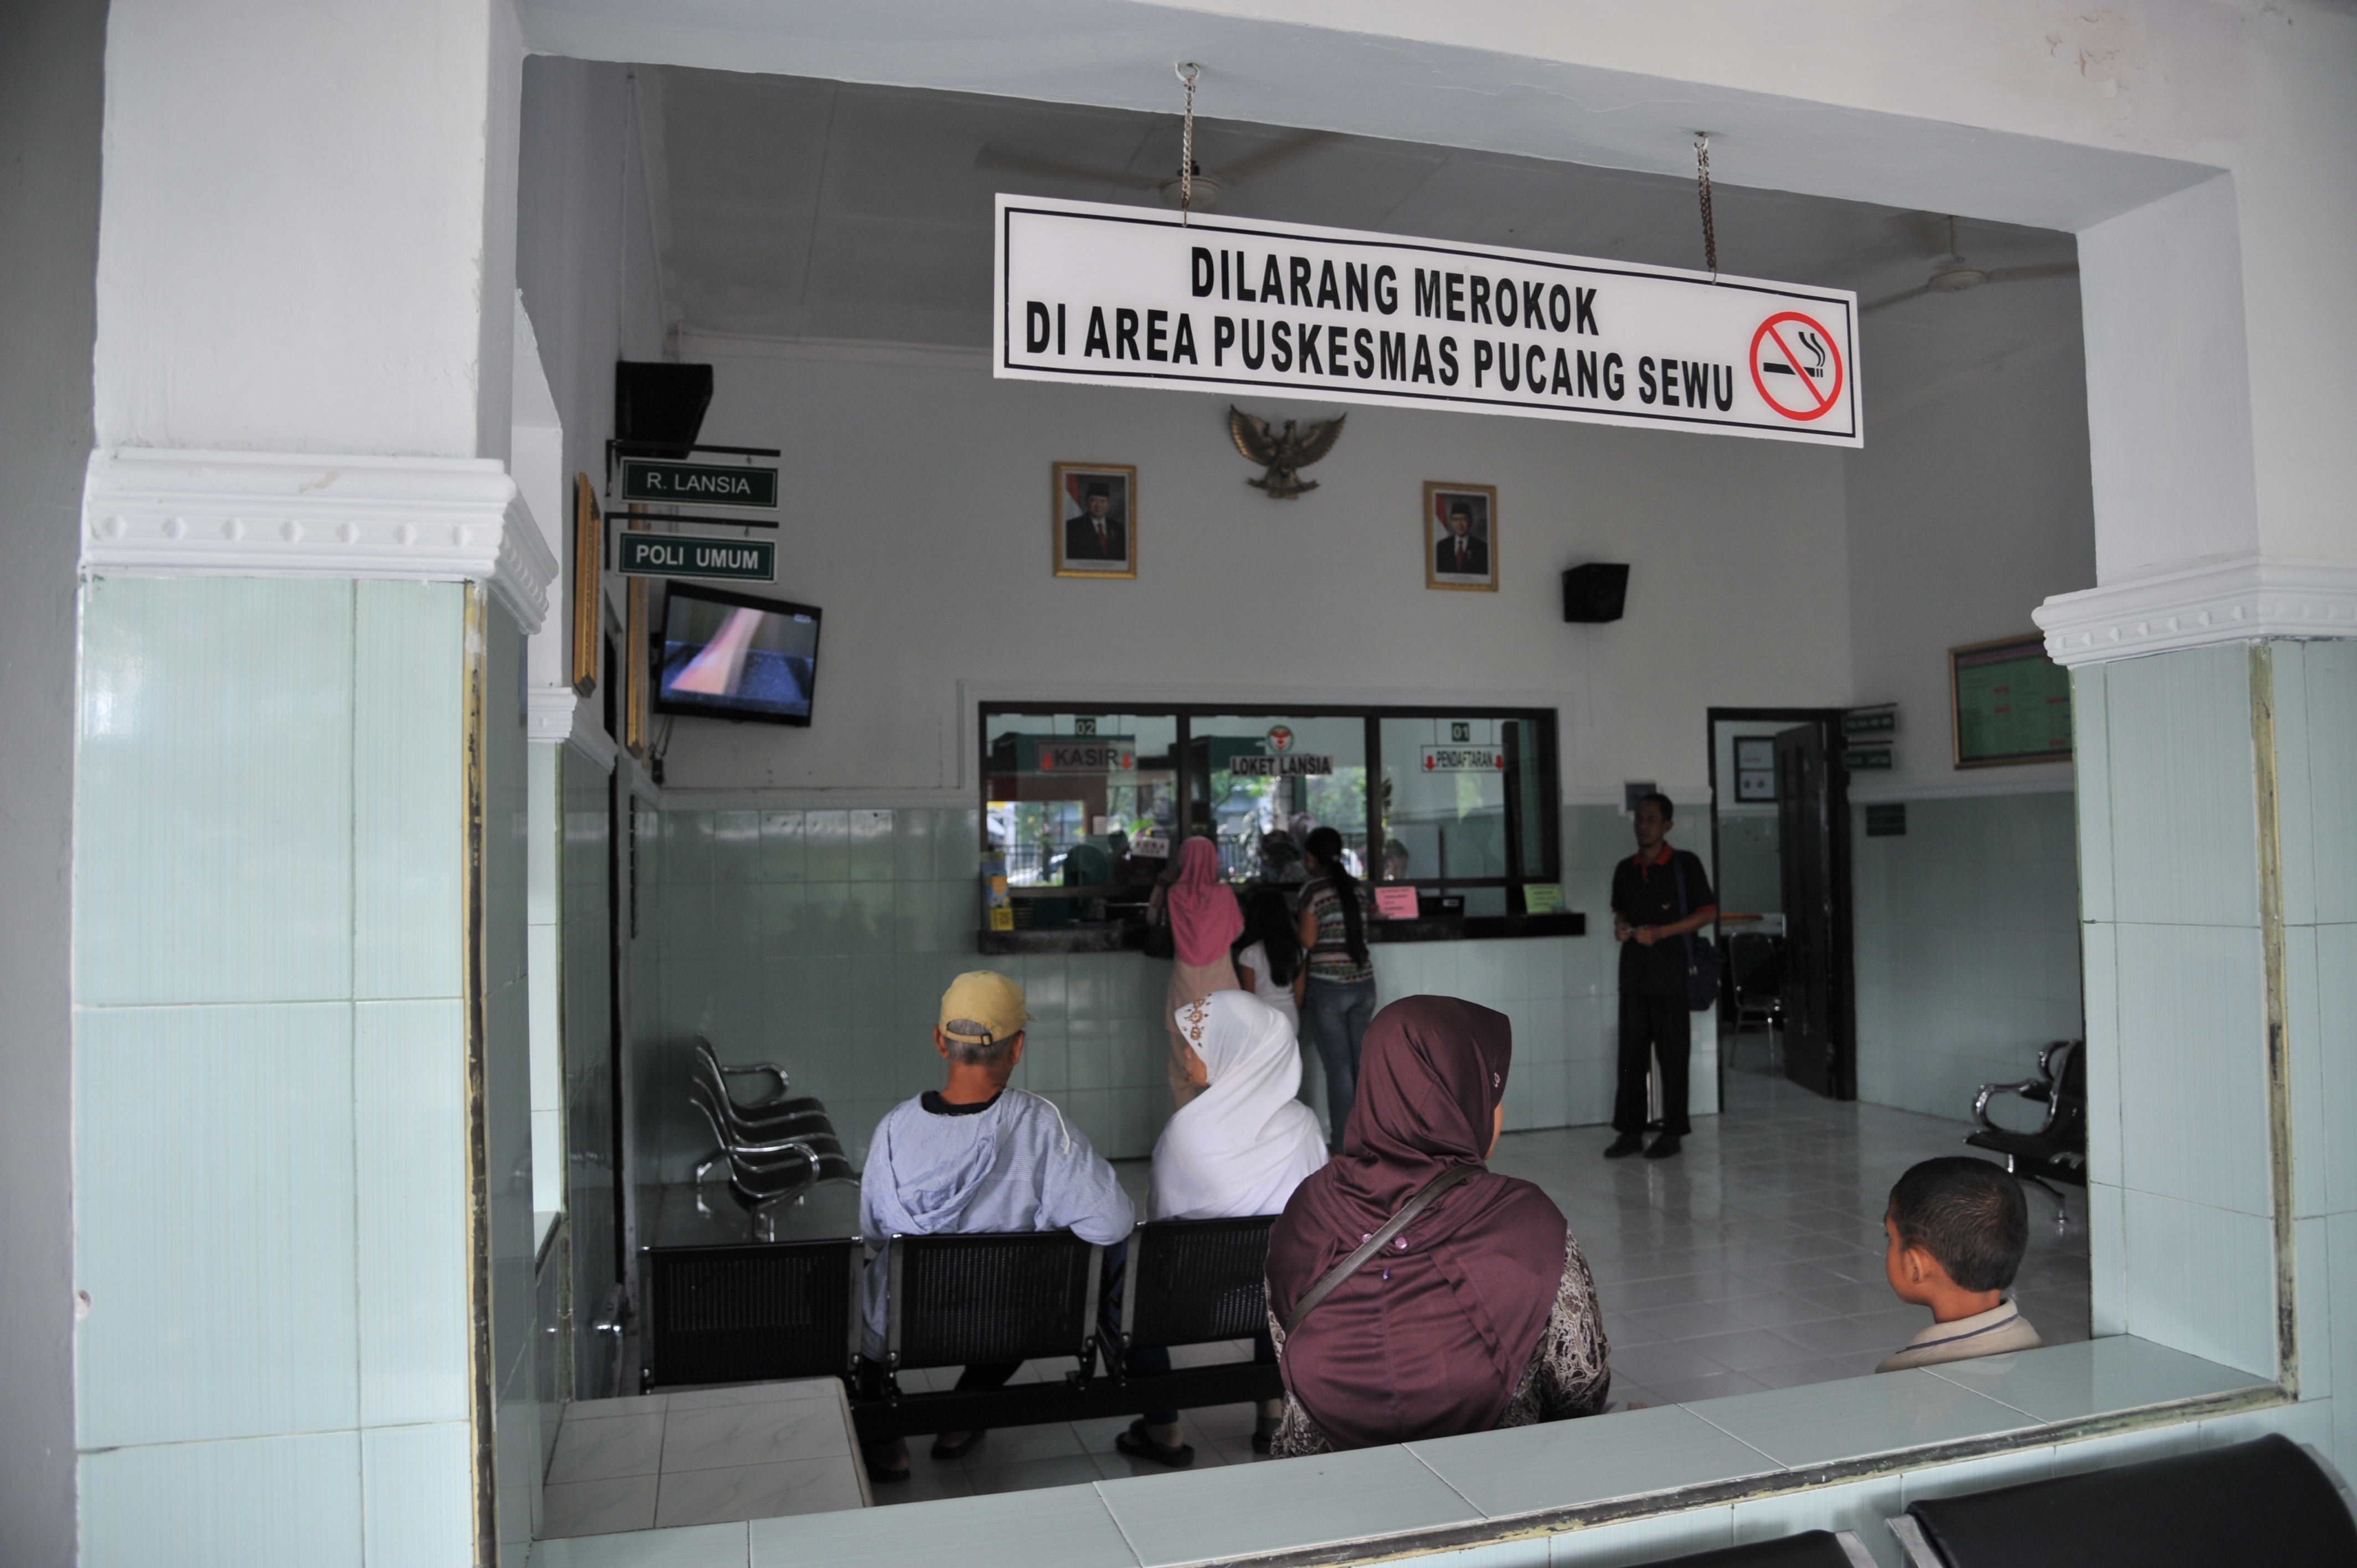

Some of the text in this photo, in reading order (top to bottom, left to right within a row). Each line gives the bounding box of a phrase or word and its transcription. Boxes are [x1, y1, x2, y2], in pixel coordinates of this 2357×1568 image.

[1192, 246, 1599, 336] DILARANG MEROKOK
[1026, 301, 1733, 412] DI AREA PUSKESMAS PUCANG SEWU
[647, 472, 751, 494] R. LANSIA
[636, 544, 758, 569] POLI UMUM
[1075, 721, 1095, 735] 02
[1453, 725, 1469, 739] 01
[1054, 749, 1119, 766] KASIR
[1232, 756, 1332, 775] LOKET LANSIA
[1437, 751, 1493, 767] PENDAFTARAN
